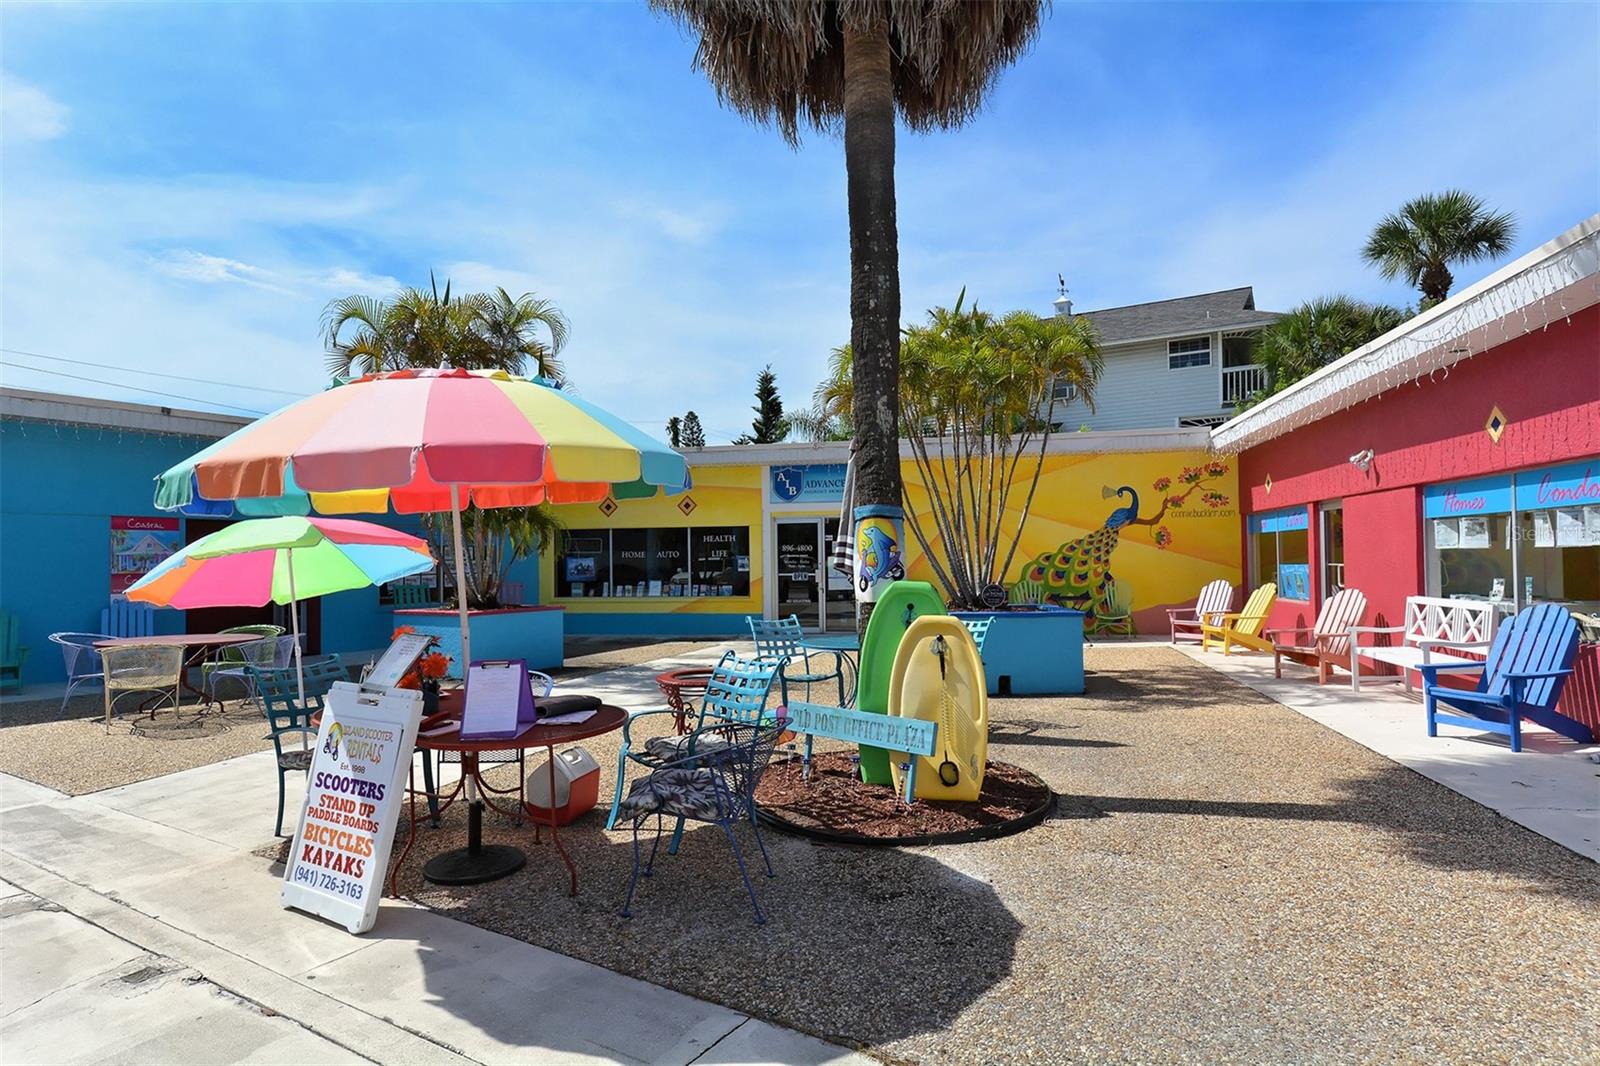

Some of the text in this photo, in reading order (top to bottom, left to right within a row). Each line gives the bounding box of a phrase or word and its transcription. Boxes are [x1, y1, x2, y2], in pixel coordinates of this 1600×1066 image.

[1443, 488, 1487, 513] Homes
[703, 535, 736, 543] HEALTH
[621, 550, 680, 559] HOME AUTO
[815, 713, 839, 734] POST
[843, 718, 884, 742] OFFICE
[887, 725, 925, 749] PLAZA
[347, 739, 383, 764] RENTALS
[315, 771, 386, 801] SCOOTERS
[318, 794, 376, 818] STAND UP
[306, 807, 380, 835] PADDLE BOARDS
[303, 822, 374, 859] BICYCLES
[301, 844, 366, 880] KAYAKS
[294, 864, 363, 900] (941) 726-3163
